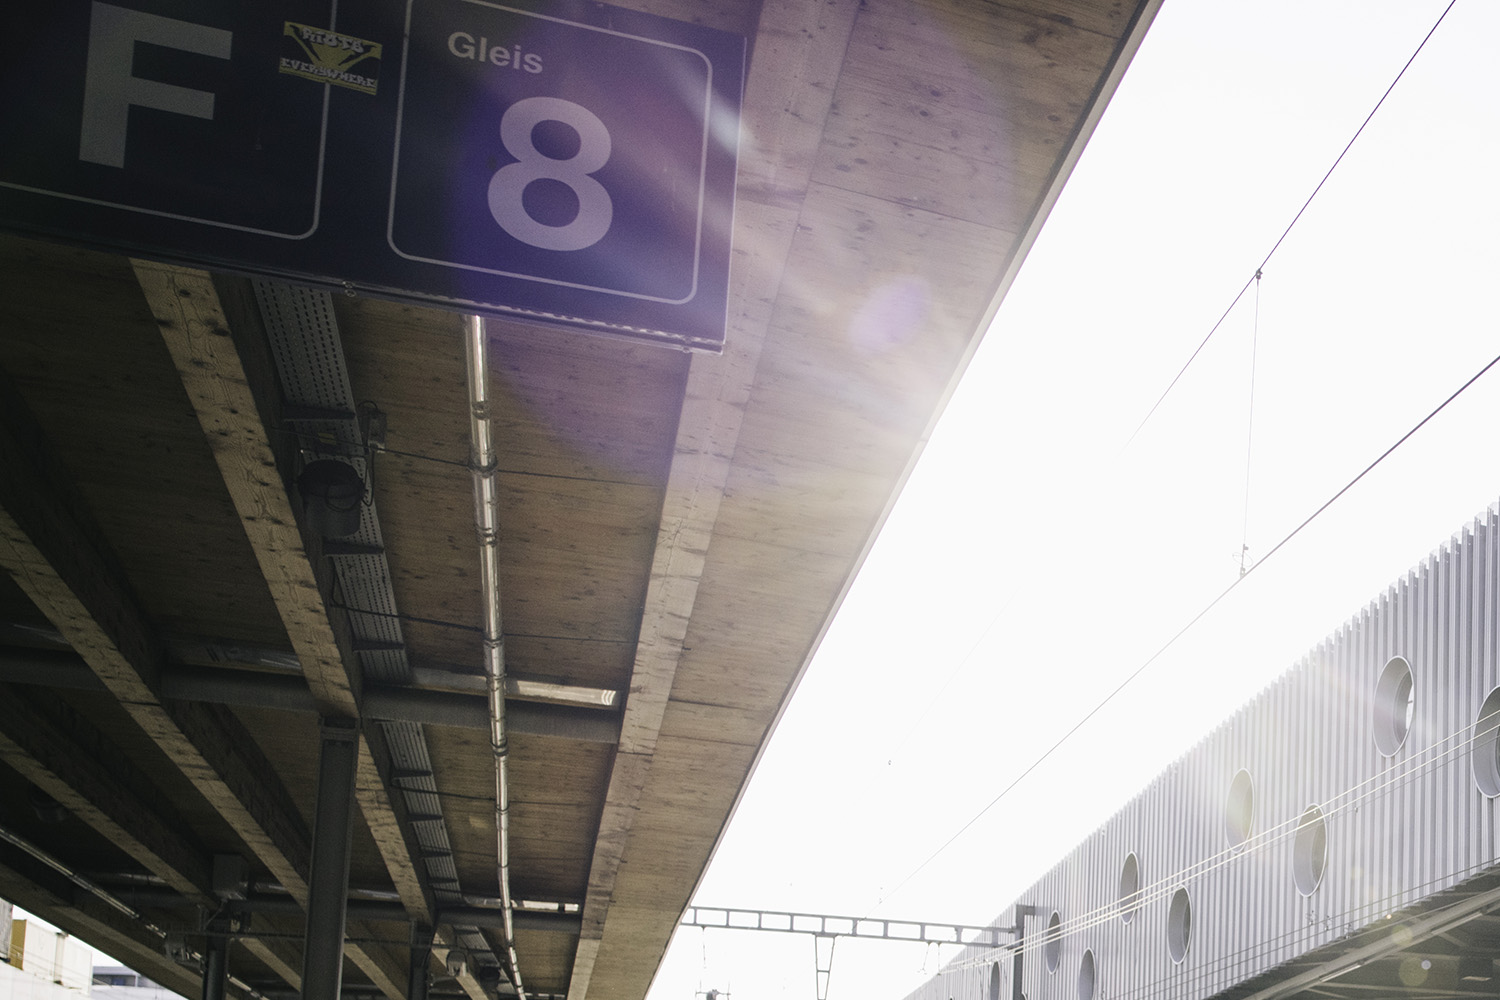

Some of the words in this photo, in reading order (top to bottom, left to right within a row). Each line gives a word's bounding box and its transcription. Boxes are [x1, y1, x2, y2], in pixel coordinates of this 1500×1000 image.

[78, 2, 232, 169] F
[280, 57, 377, 88] EVERYWHERE
[448, 31, 543, 74] Gleis
[488, 97, 612, 252] 8
